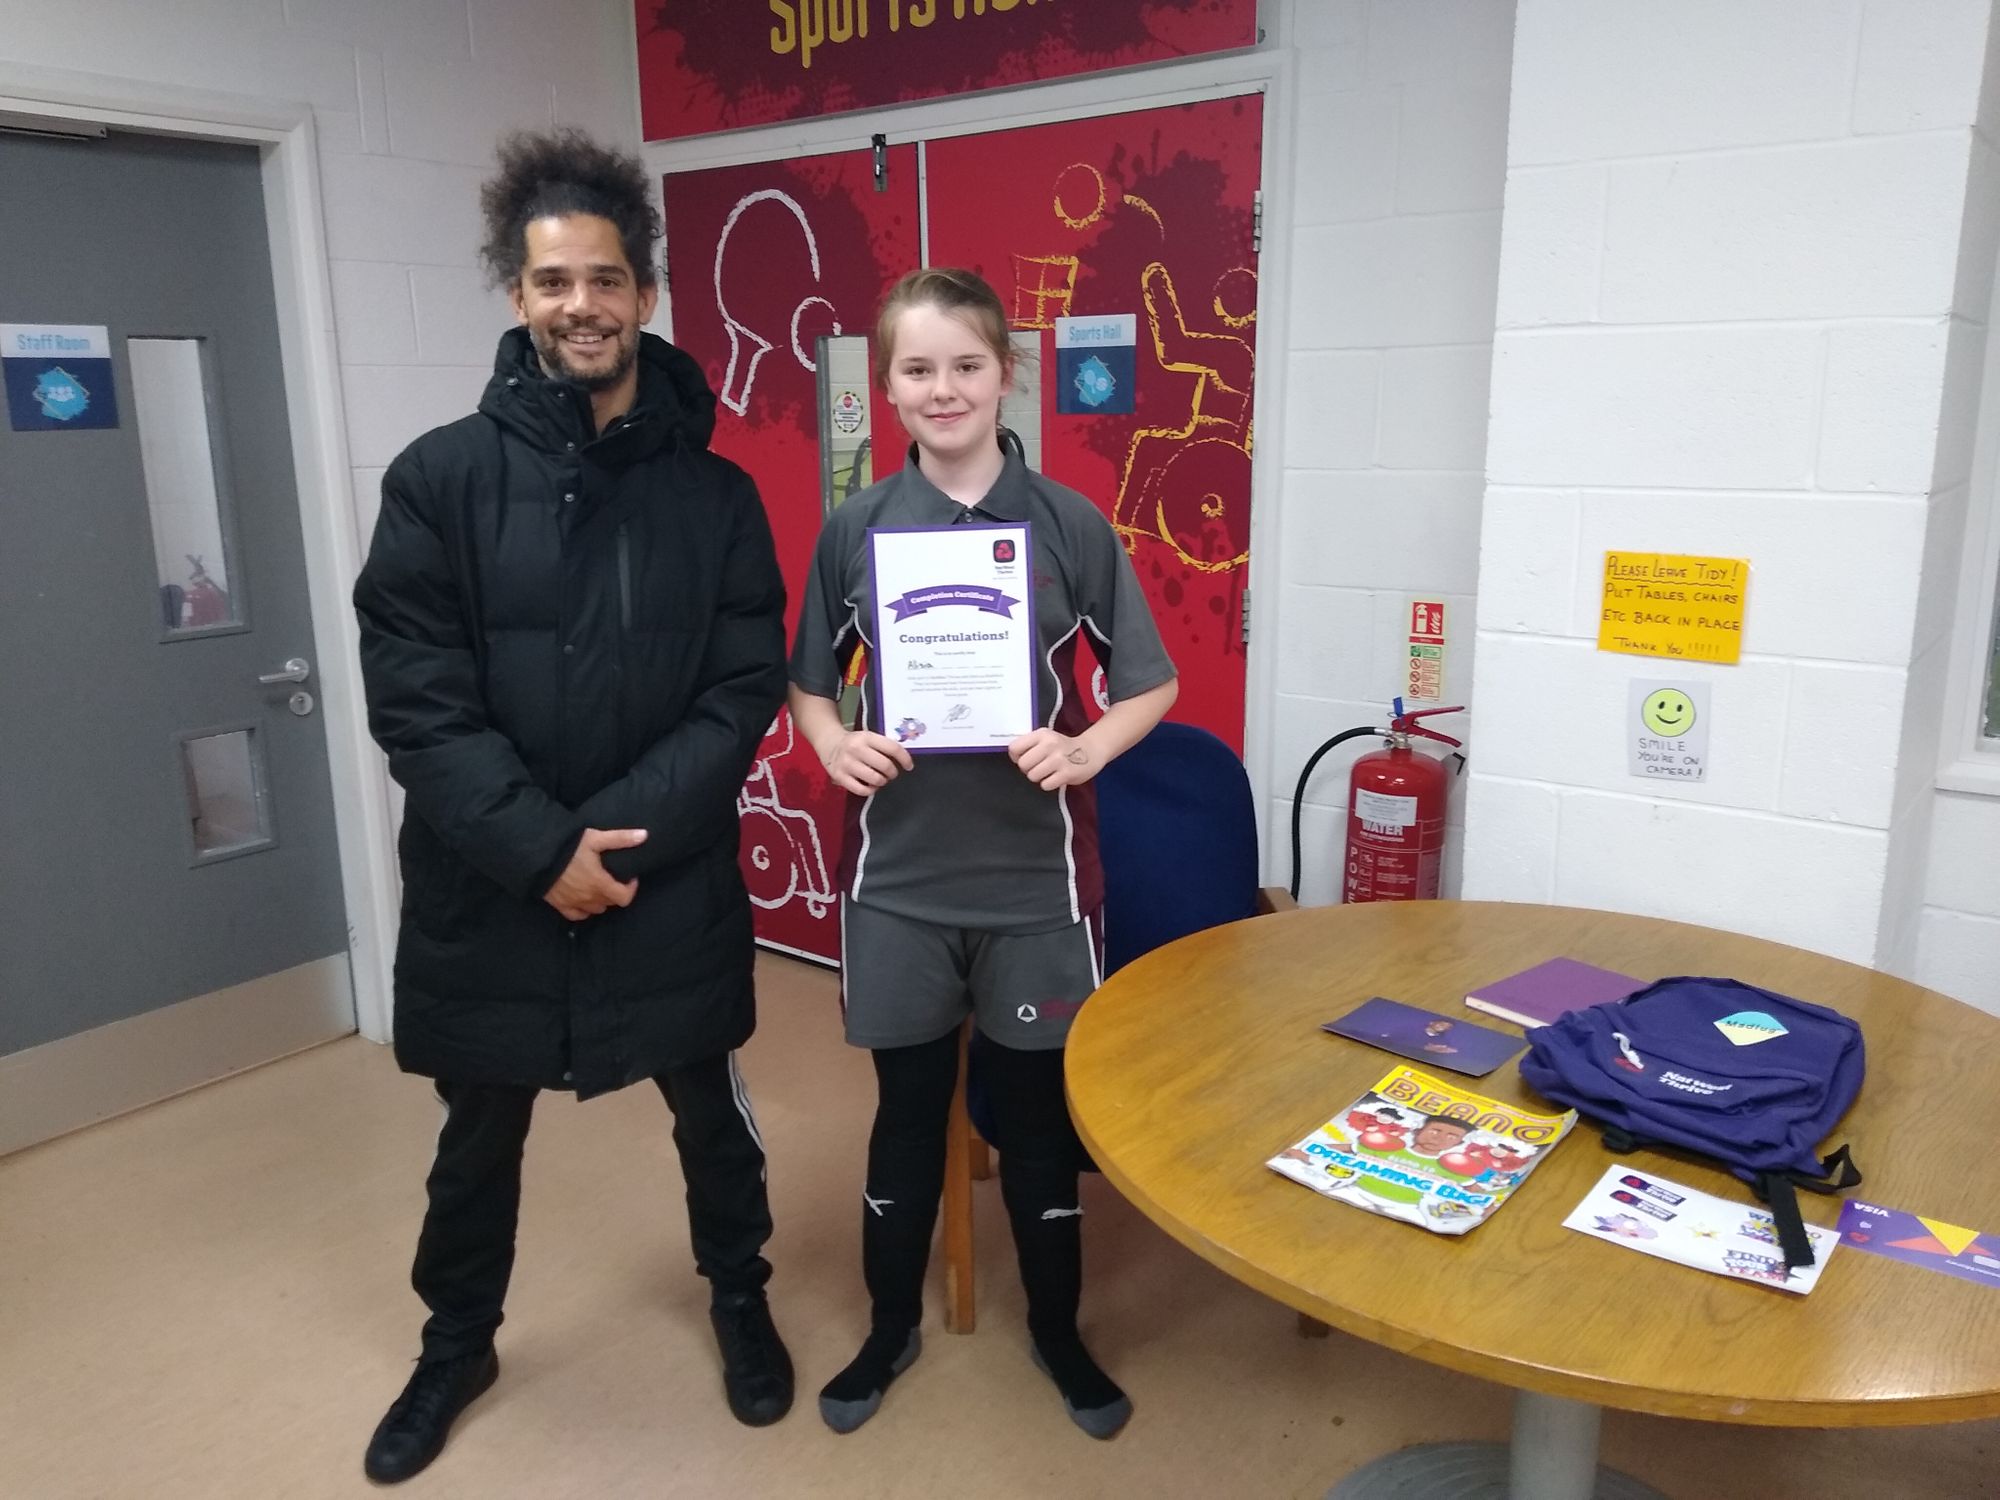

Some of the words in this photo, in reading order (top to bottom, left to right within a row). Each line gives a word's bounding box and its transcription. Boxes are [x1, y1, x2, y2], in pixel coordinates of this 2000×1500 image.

[17, 333, 52, 350] Staff
[55, 334, 90, 350] Room
[1069, 325, 1101, 342] Sports
[1103, 323, 1122, 339] Hall
[1607, 555, 1648, 577] PLEASE
[1653, 559, 1688, 578] LEAVE
[910, 592, 954, 604] Completion
[954, 591, 995, 602] Certificate
[1605, 582, 1633, 599] PUT
[1693, 592, 1739, 605] CHAIRS
[1602, 609, 1626, 622] ETC
[1633, 611, 1671, 625] BACK
[1678, 617, 1692, 627] IN
[1699, 617, 1741, 631] PLACE
[899, 630, 1009, 645] Congratulations!
[1613, 636, 1657, 651] THANK
[1638, 737, 1686, 752] SMILE
[1362, 819, 1404, 837] WATER
[1383, 1077, 1555, 1143] BEANO
[1305, 1143, 1434, 1192] DREAMING
[1853, 1202, 1891, 1218] VISA
